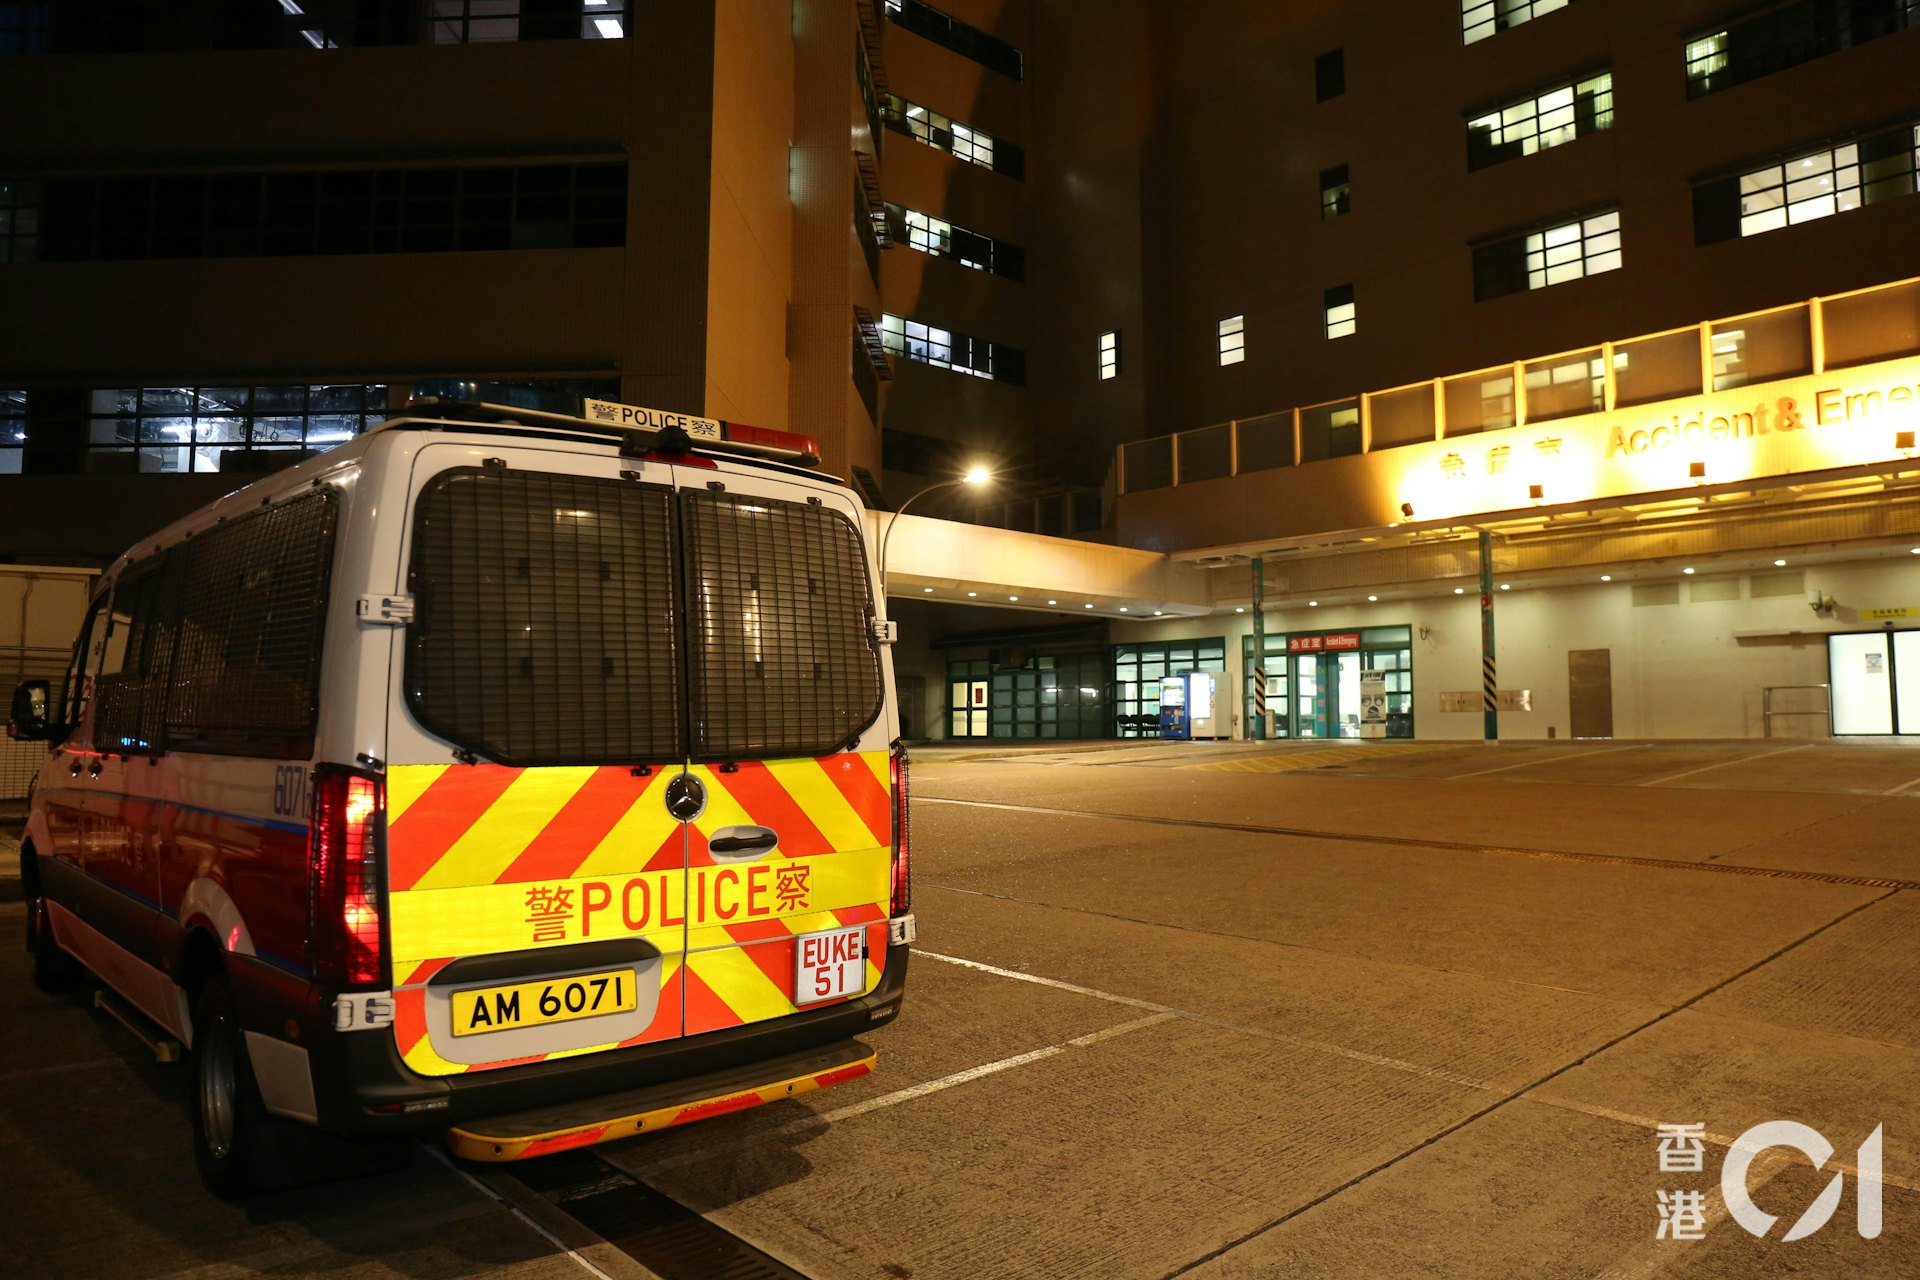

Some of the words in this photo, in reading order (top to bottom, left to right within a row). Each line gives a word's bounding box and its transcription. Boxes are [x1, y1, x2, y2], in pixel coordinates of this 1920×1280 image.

[1604, 403, 1770, 458] Accident
[1774, 396, 1805, 432] &
[1815, 384, 1920, 426] Eme
[803, 932, 860, 968] EUKE
[815, 963, 844, 996] 51
[470, 991, 520, 1028] AM
[539, 977, 622, 1017] 6071
